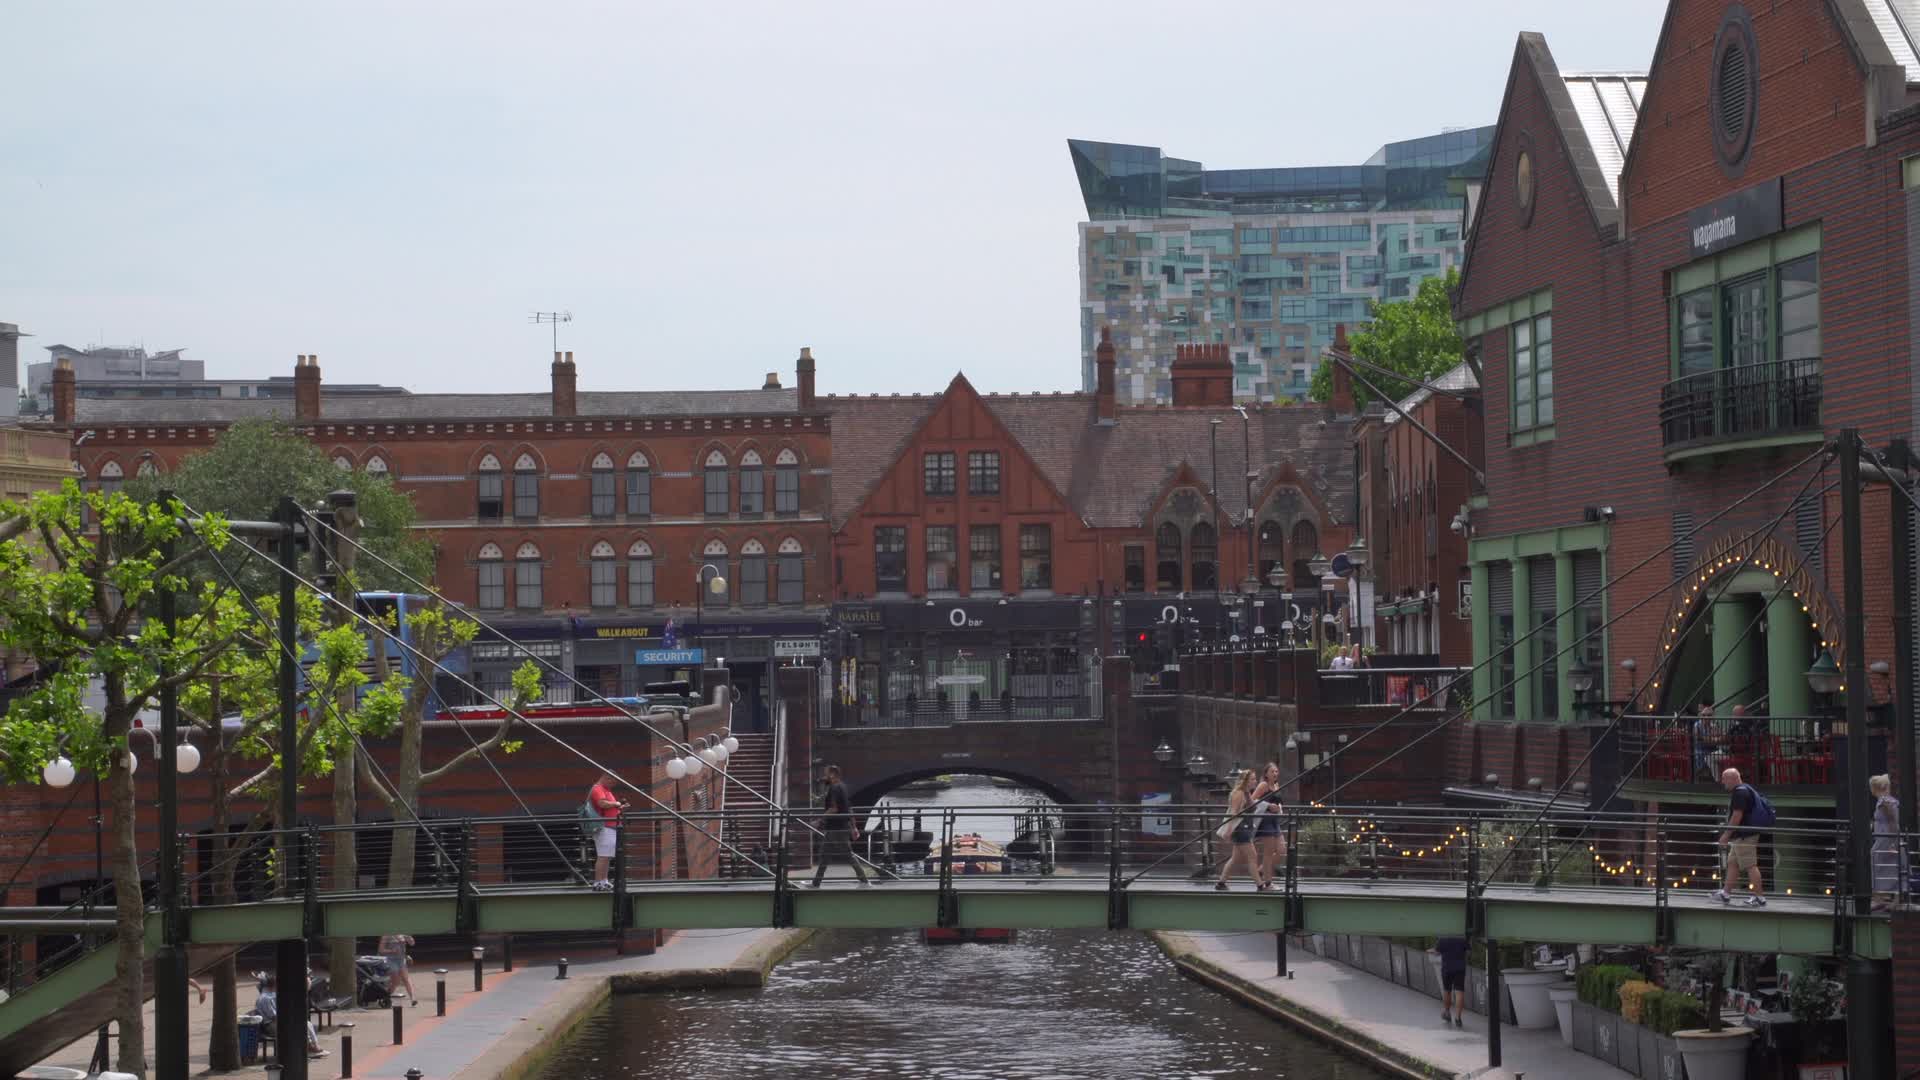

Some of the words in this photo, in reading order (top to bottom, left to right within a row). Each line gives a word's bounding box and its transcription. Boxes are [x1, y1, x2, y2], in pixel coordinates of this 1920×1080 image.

[1693, 216, 1736, 249] wagamama
[950, 608, 966, 626] O
[968, 618, 983, 626] bar
[597, 628, 648, 637] WALKABOUT
[643, 652, 693, 662] SECURITY
